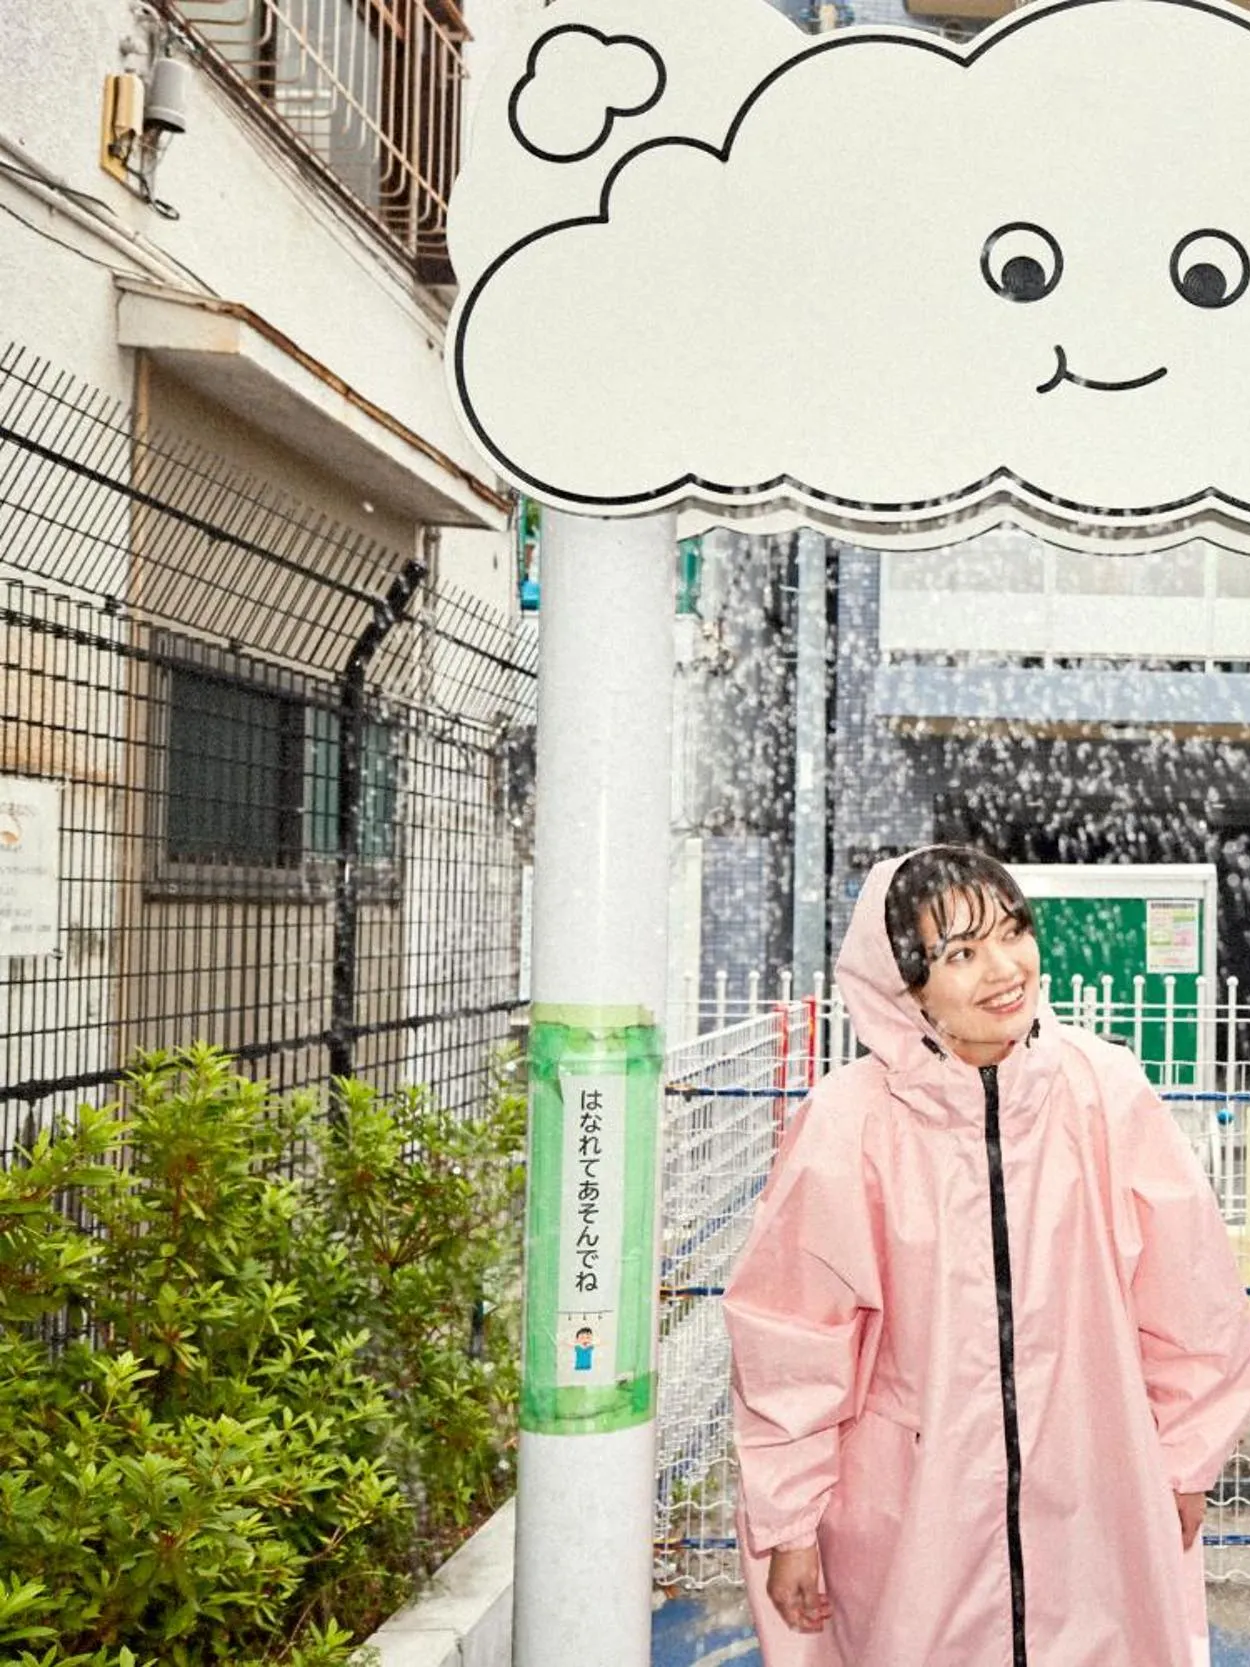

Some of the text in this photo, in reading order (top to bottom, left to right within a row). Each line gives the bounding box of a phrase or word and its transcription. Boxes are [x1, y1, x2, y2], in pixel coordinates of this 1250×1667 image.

[575, 1089, 603, 1292] はなれてあそんでね
